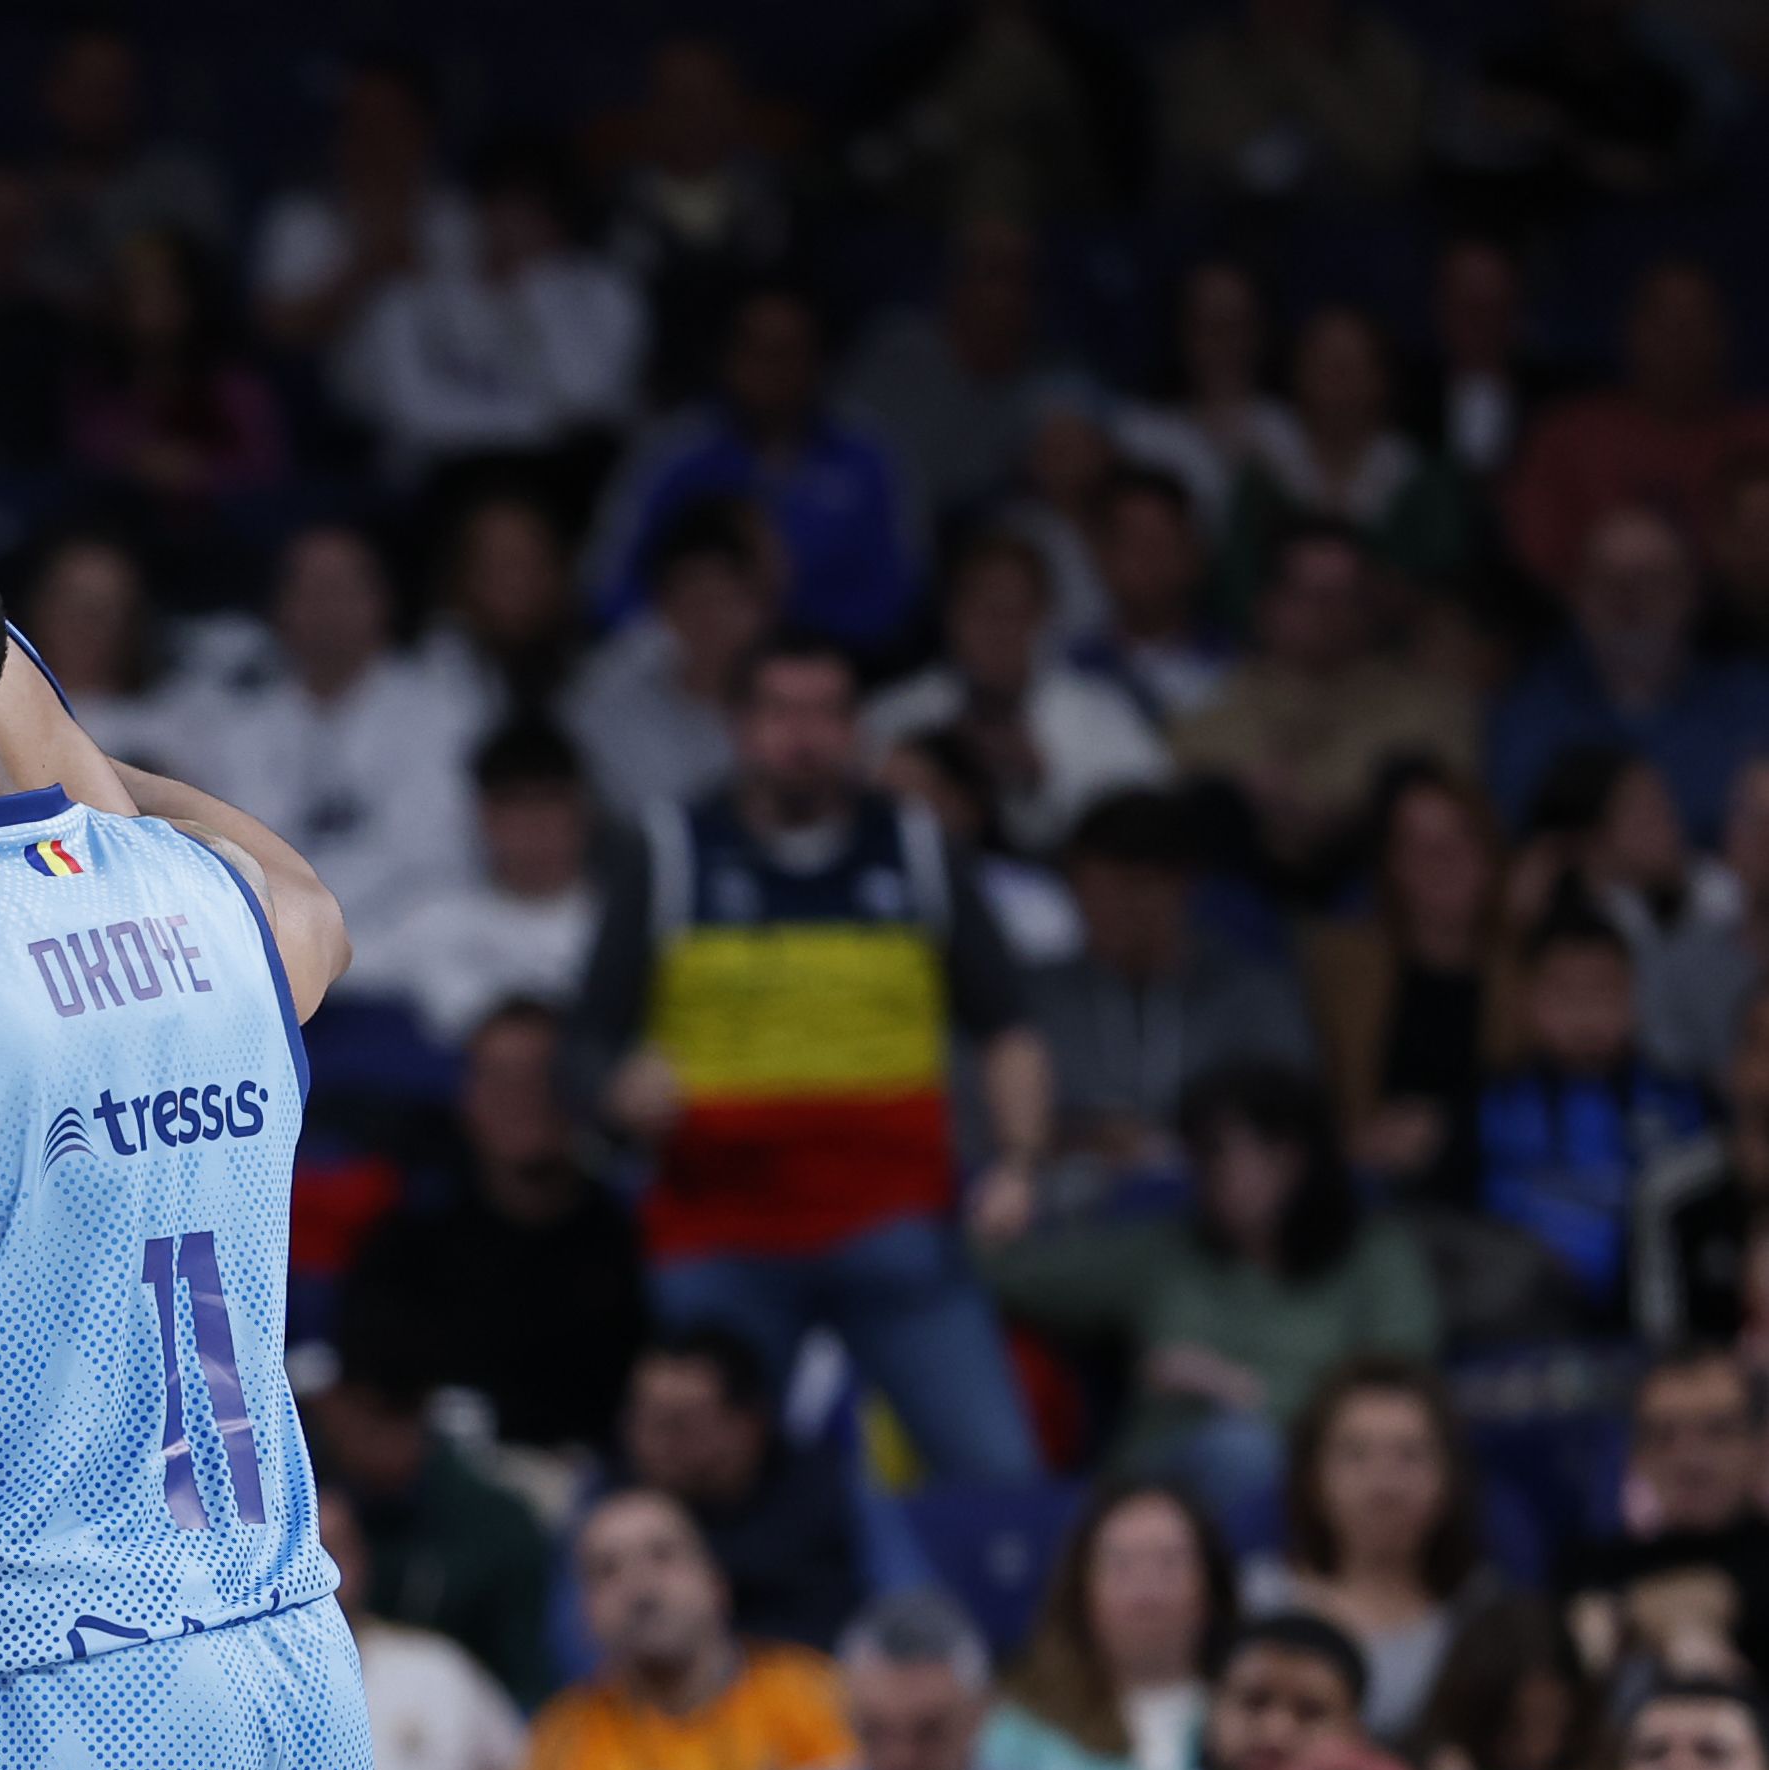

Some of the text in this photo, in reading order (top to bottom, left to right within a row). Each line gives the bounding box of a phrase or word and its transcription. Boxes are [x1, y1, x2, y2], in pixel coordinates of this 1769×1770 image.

[27, 914, 213, 1018] OKOYE
[93, 1080, 269, 1156] tressis
[141, 1231, 266, 1530] 11
